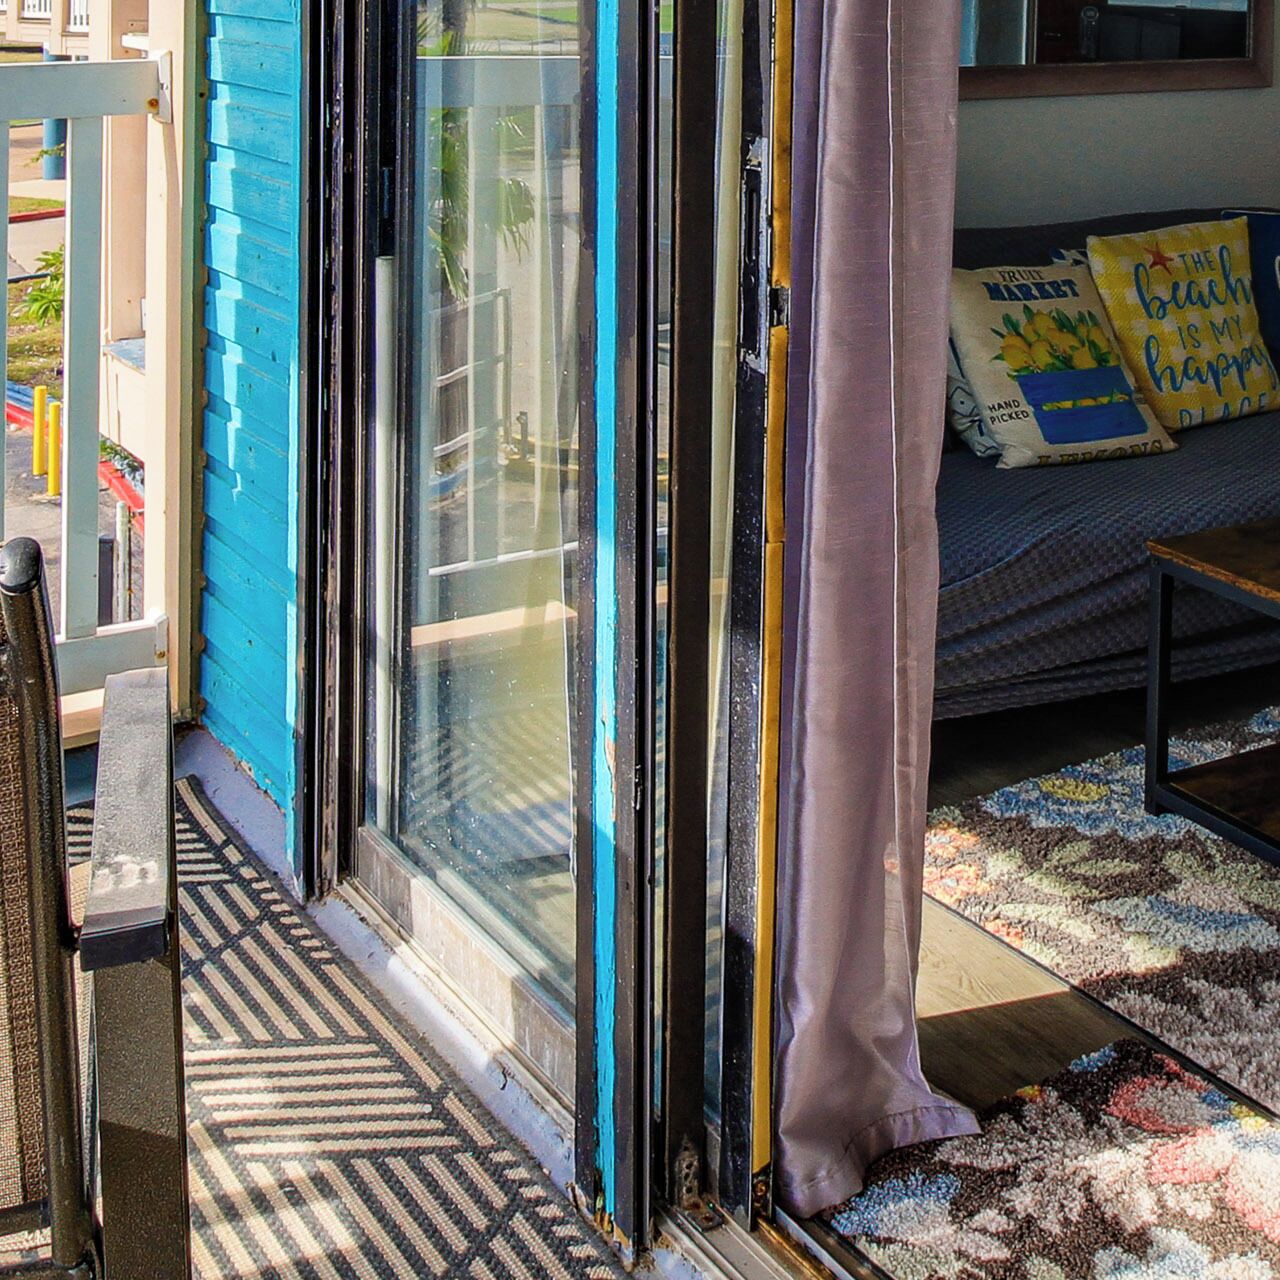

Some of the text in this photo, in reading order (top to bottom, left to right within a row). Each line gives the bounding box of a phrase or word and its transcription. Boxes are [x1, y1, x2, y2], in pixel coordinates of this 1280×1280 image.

[1178, 250, 1214, 275] THE
[998, 269, 1043, 282] FRUIT
[1134, 244, 1251, 320] beach
[982, 279, 1080, 301] MARKET
[1179, 316, 1243, 350] IS MY
[1145, 334, 1278, 397] happy
[988, 399, 1020, 413] HAND
[989, 410, 1029, 425] PICKED
